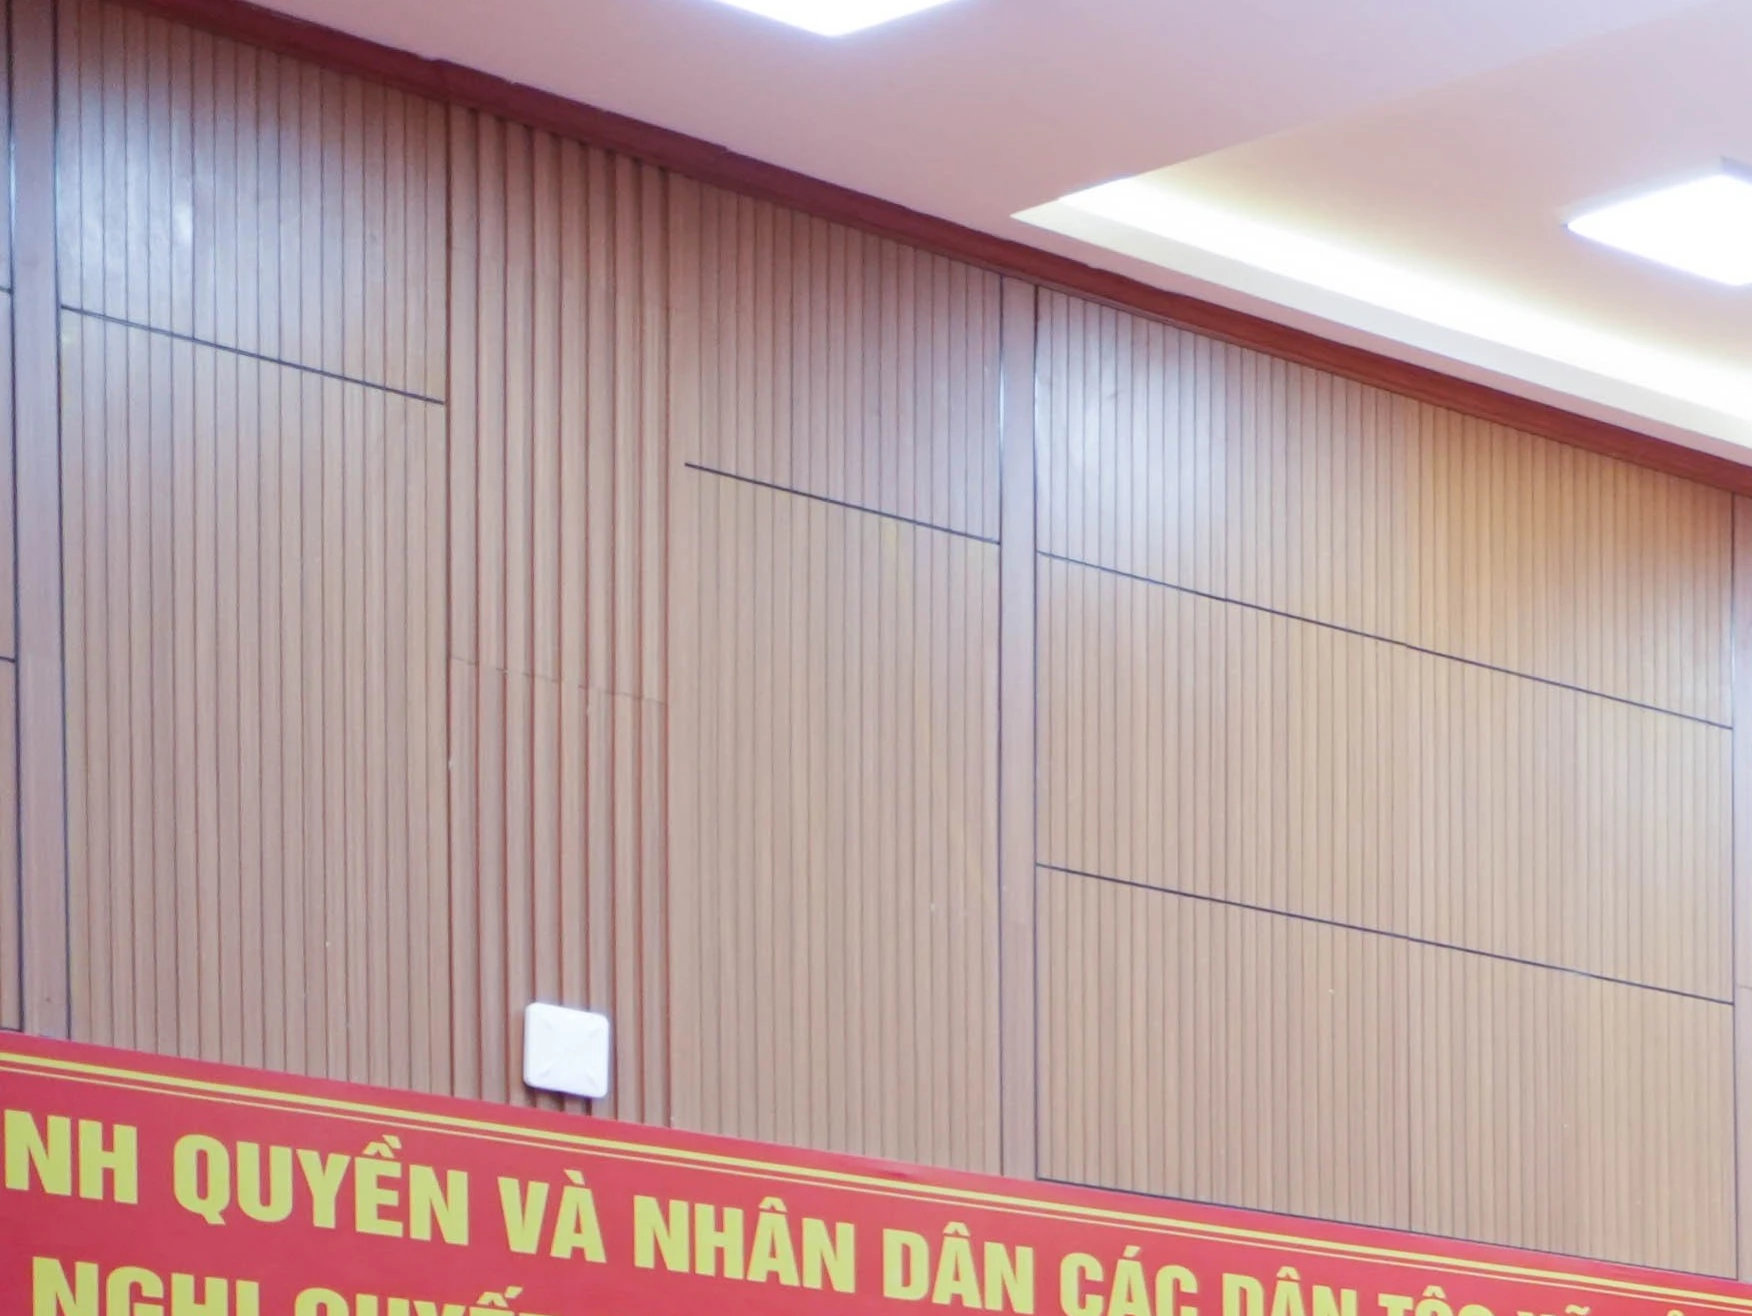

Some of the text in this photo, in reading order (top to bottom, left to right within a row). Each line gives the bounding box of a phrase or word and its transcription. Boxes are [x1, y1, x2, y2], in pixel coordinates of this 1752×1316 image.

[175, 1133, 467, 1243] QUYỀN
[500, 1170, 603, 1260] VÀ
[635, 1195, 854, 1291] NHÂN
[884, 1222, 1033, 1312] DÂN
